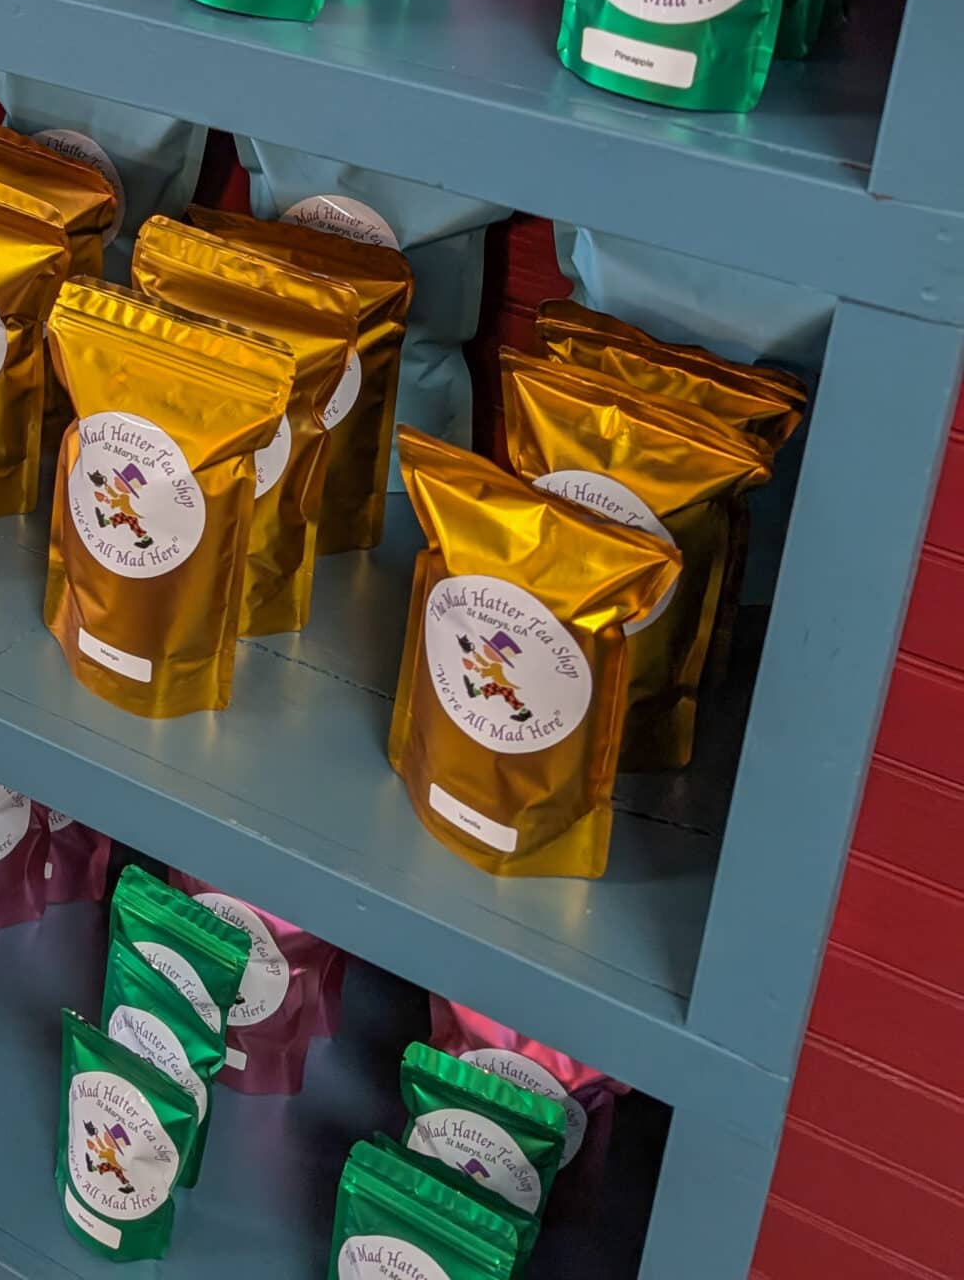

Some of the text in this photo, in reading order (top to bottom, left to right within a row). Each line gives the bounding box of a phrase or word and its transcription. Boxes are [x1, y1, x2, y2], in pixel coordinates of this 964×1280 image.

[613, 49, 655, 68] Pineapple
[80, 422, 195, 509] Mad Hatter Tea Shop
[94, 537, 112, 559] All
[116, 550, 145, 568] Mad
[430, 587, 580, 680] The Mad Hatter Tea Shop
[466, 607, 477, 618] St
[512, 623, 529, 637] GA
[464, 710, 485, 732] All
[490, 723, 524, 742] Mad
[78, 1081, 157, 1142] Mad Hatter Tea
[425, 1119, 517, 1172] Mad Hatter Tea
